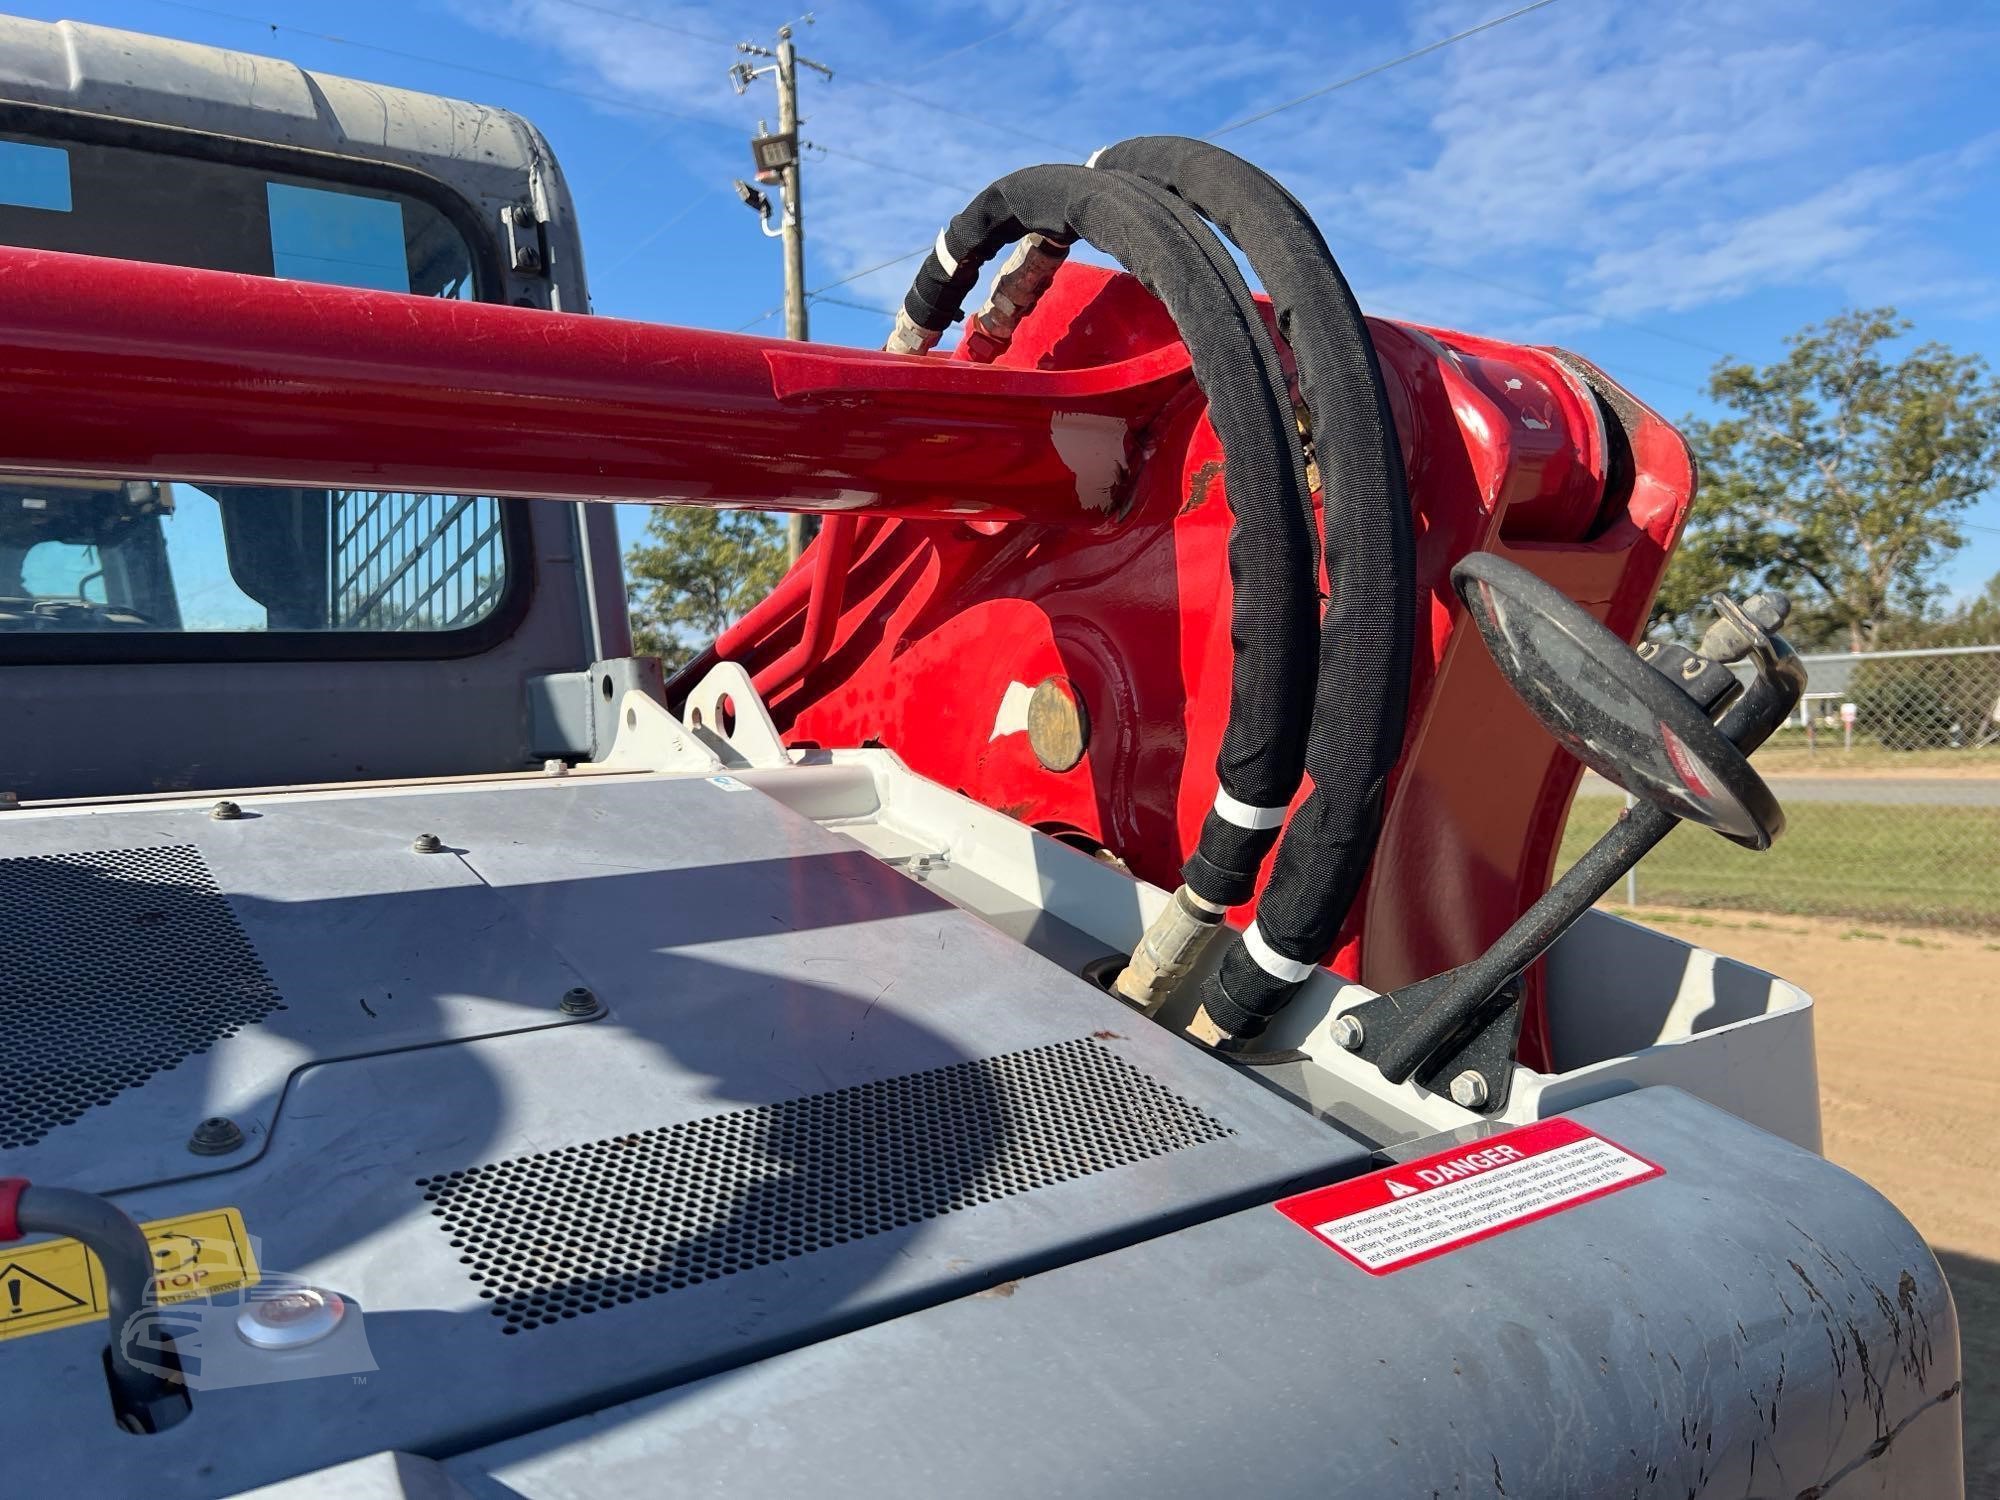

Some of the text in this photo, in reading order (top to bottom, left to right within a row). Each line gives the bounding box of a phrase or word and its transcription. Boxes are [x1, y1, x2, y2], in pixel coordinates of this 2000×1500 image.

[1416, 1144, 1525, 1185] DANGER
[1325, 1221, 1363, 1237] Inspect
[1354, 1210, 1393, 1226] machine
[1386, 1204, 1413, 1217] daily
[1428, 1186, 1468, 1203] build-up
[1466, 1170, 1515, 1188] combustible
[1338, 1232, 1366, 1245] wood
[1361, 1224, 1393, 1239] chips,
[1384, 1217, 1411, 1230] dust,
[1446, 1195, 1478, 1208] around
[1351, 1239, 1390, 1256] battery,
[1396, 1225, 1425, 1238] under
[1444, 1208, 1478, 1223] Proper
[1381, 1245, 1408, 1257] other
[1402, 1229, 1454, 1250] combustible
[1447, 1217, 1487, 1234] materials
[1481, 1211, 1508, 1224] prior
[157, 1270, 208, 1290] TOP
